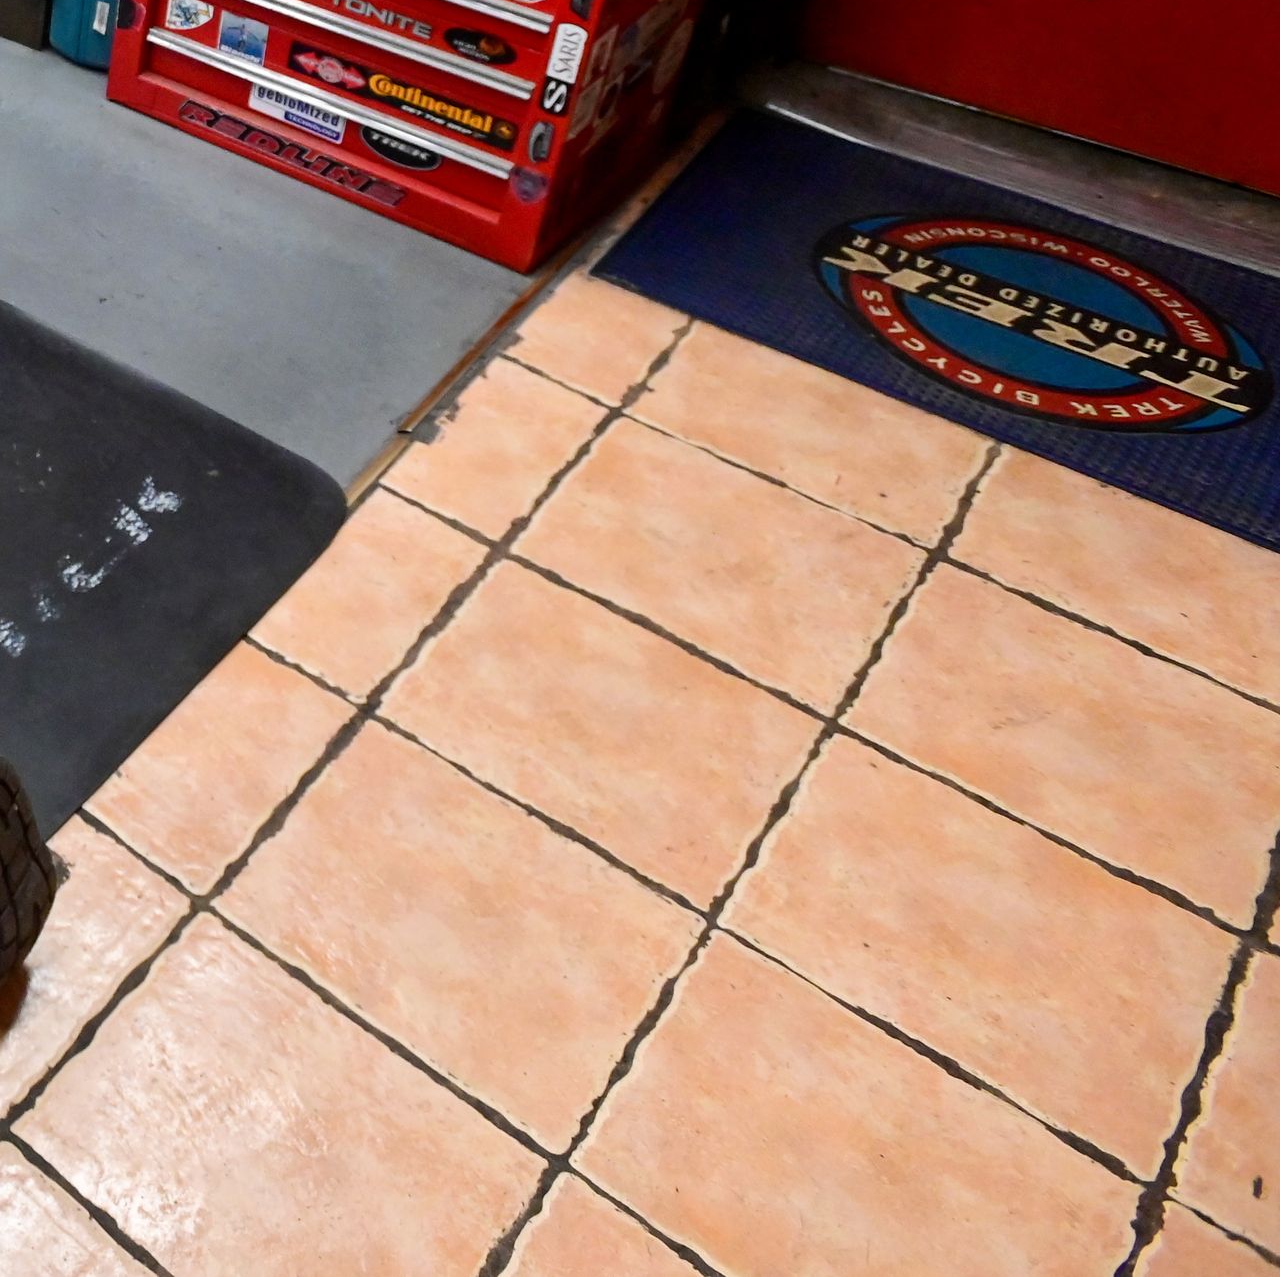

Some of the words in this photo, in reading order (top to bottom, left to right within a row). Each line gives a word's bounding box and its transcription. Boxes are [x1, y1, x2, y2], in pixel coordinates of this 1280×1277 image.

[550, 28, 581, 77] SARIS
[368, 73, 493, 133] Continental
[849, 234, 977, 289] DEALER
[902, 225, 1070, 257] WISCONSIN
[821, 245, 1253, 413] TREK
[1088, 255, 1215, 347] WATERLOO
[859, 285, 1042, 410] BICYCLES
[998, 286, 1252, 382] AUTHORIZED
[1069, 394, 1187, 421] TREK
